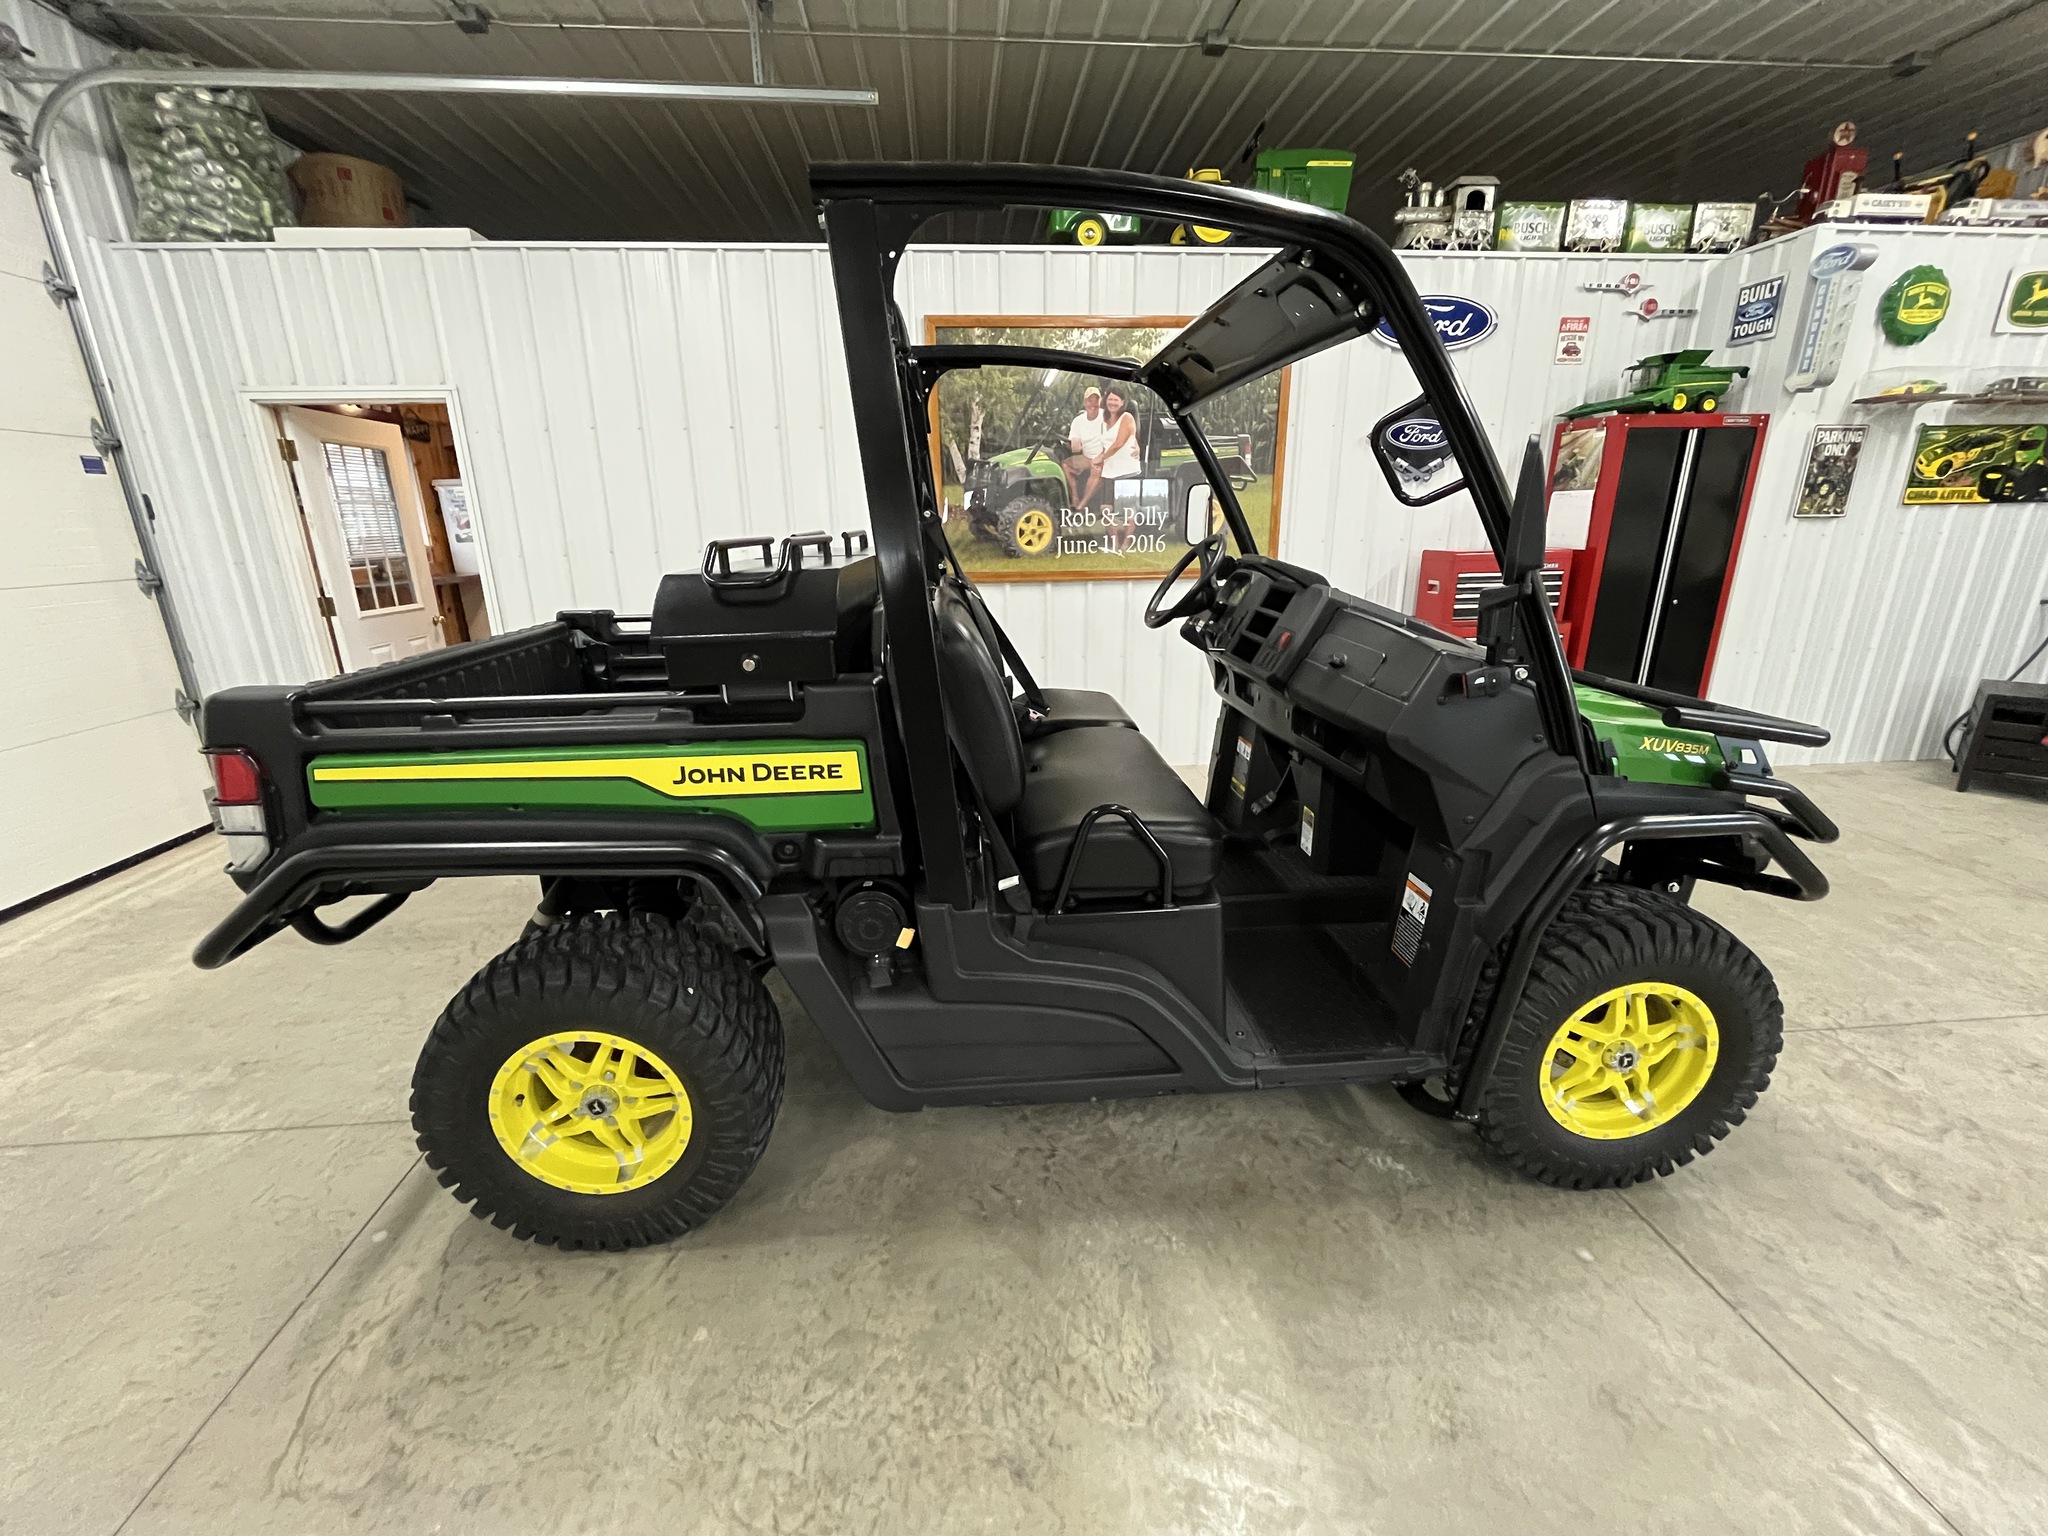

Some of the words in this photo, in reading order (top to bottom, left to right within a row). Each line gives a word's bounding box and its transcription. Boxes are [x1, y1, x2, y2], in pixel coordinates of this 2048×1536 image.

[1513, 222, 1550, 234] BUSCH
[1643, 223, 1678, 236] BUSCH
[1812, 250, 1855, 273] Ford
[1738, 279, 1782, 307] BUILT
[1733, 316, 1774, 338] TOUGH
[1399, 424, 1443, 443] Ford
[1815, 430, 1863, 443] PARKING
[1824, 443, 1852, 456] ONLY
[1060, 506, 1096, 528] Rob
[1100, 507, 1120, 527] &
[1122, 506, 1168, 531] Polly
[1055, 535, 1098, 559] June
[1125, 534, 1166, 553] 2016
[1638, 736, 1710, 755] XUV835M
[672, 765, 746, 785] JOHN
[751, 763, 843, 782] DEERE
